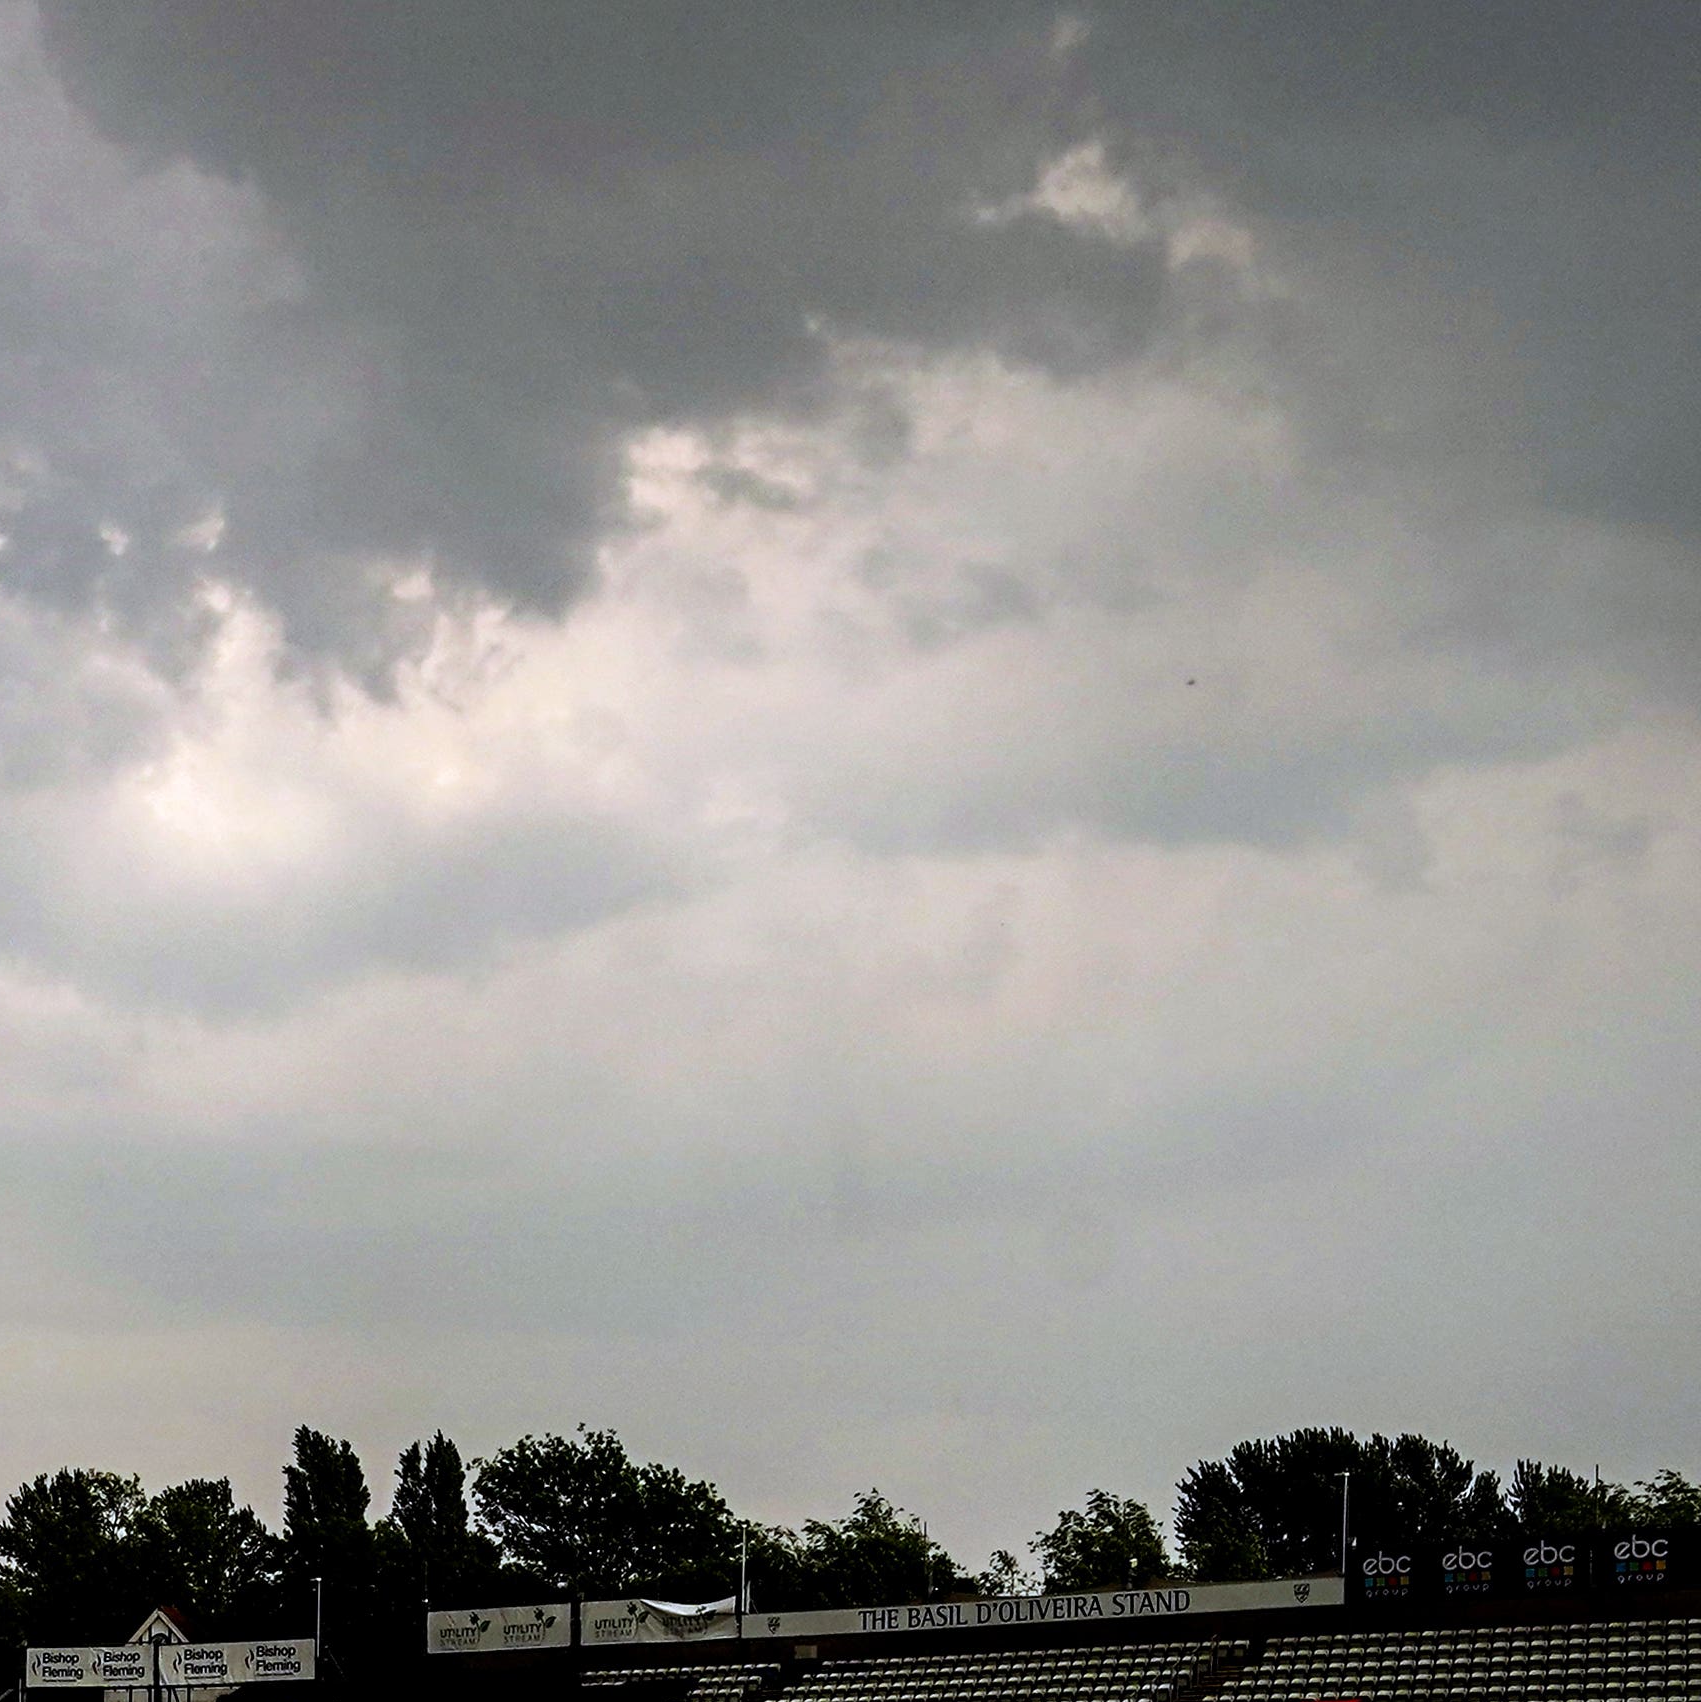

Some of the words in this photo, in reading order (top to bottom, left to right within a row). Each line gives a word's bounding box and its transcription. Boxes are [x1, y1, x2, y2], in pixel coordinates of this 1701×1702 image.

[1523, 1540, 1576, 1565] ebc
[1614, 1533, 1668, 1560] ebc
[1363, 1550, 1411, 1575] ebc
[1442, 1545, 1492, 1570] ebc
[1527, 1578, 1572, 1589] group
[1617, 1573, 1665, 1584] group
[1365, 1588, 1408, 1598] group
[1446, 1584, 1490, 1594] group
[858, 1609, 899, 1631] THE
[908, 1604, 967, 1628] BASIL
[1112, 1590, 1190, 1616] STAND
[504, 1623, 542, 1635] UTILITY
[595, 1618, 634, 1629] UTILITY
[440, 1628, 477, 1638] UTILITY
[103, 1651, 140, 1664] Bishop
[183, 1648, 223, 1661] Bishop
[256, 1645, 296, 1658] Bishop
[42, 1652, 79, 1666] Bishop
[256, 1658, 301, 1673] Fleming
[42, 1666, 84, 1680] Fleming
[103, 1665, 145, 1678] Fleming
[183, 1661, 227, 1676] Fleming
